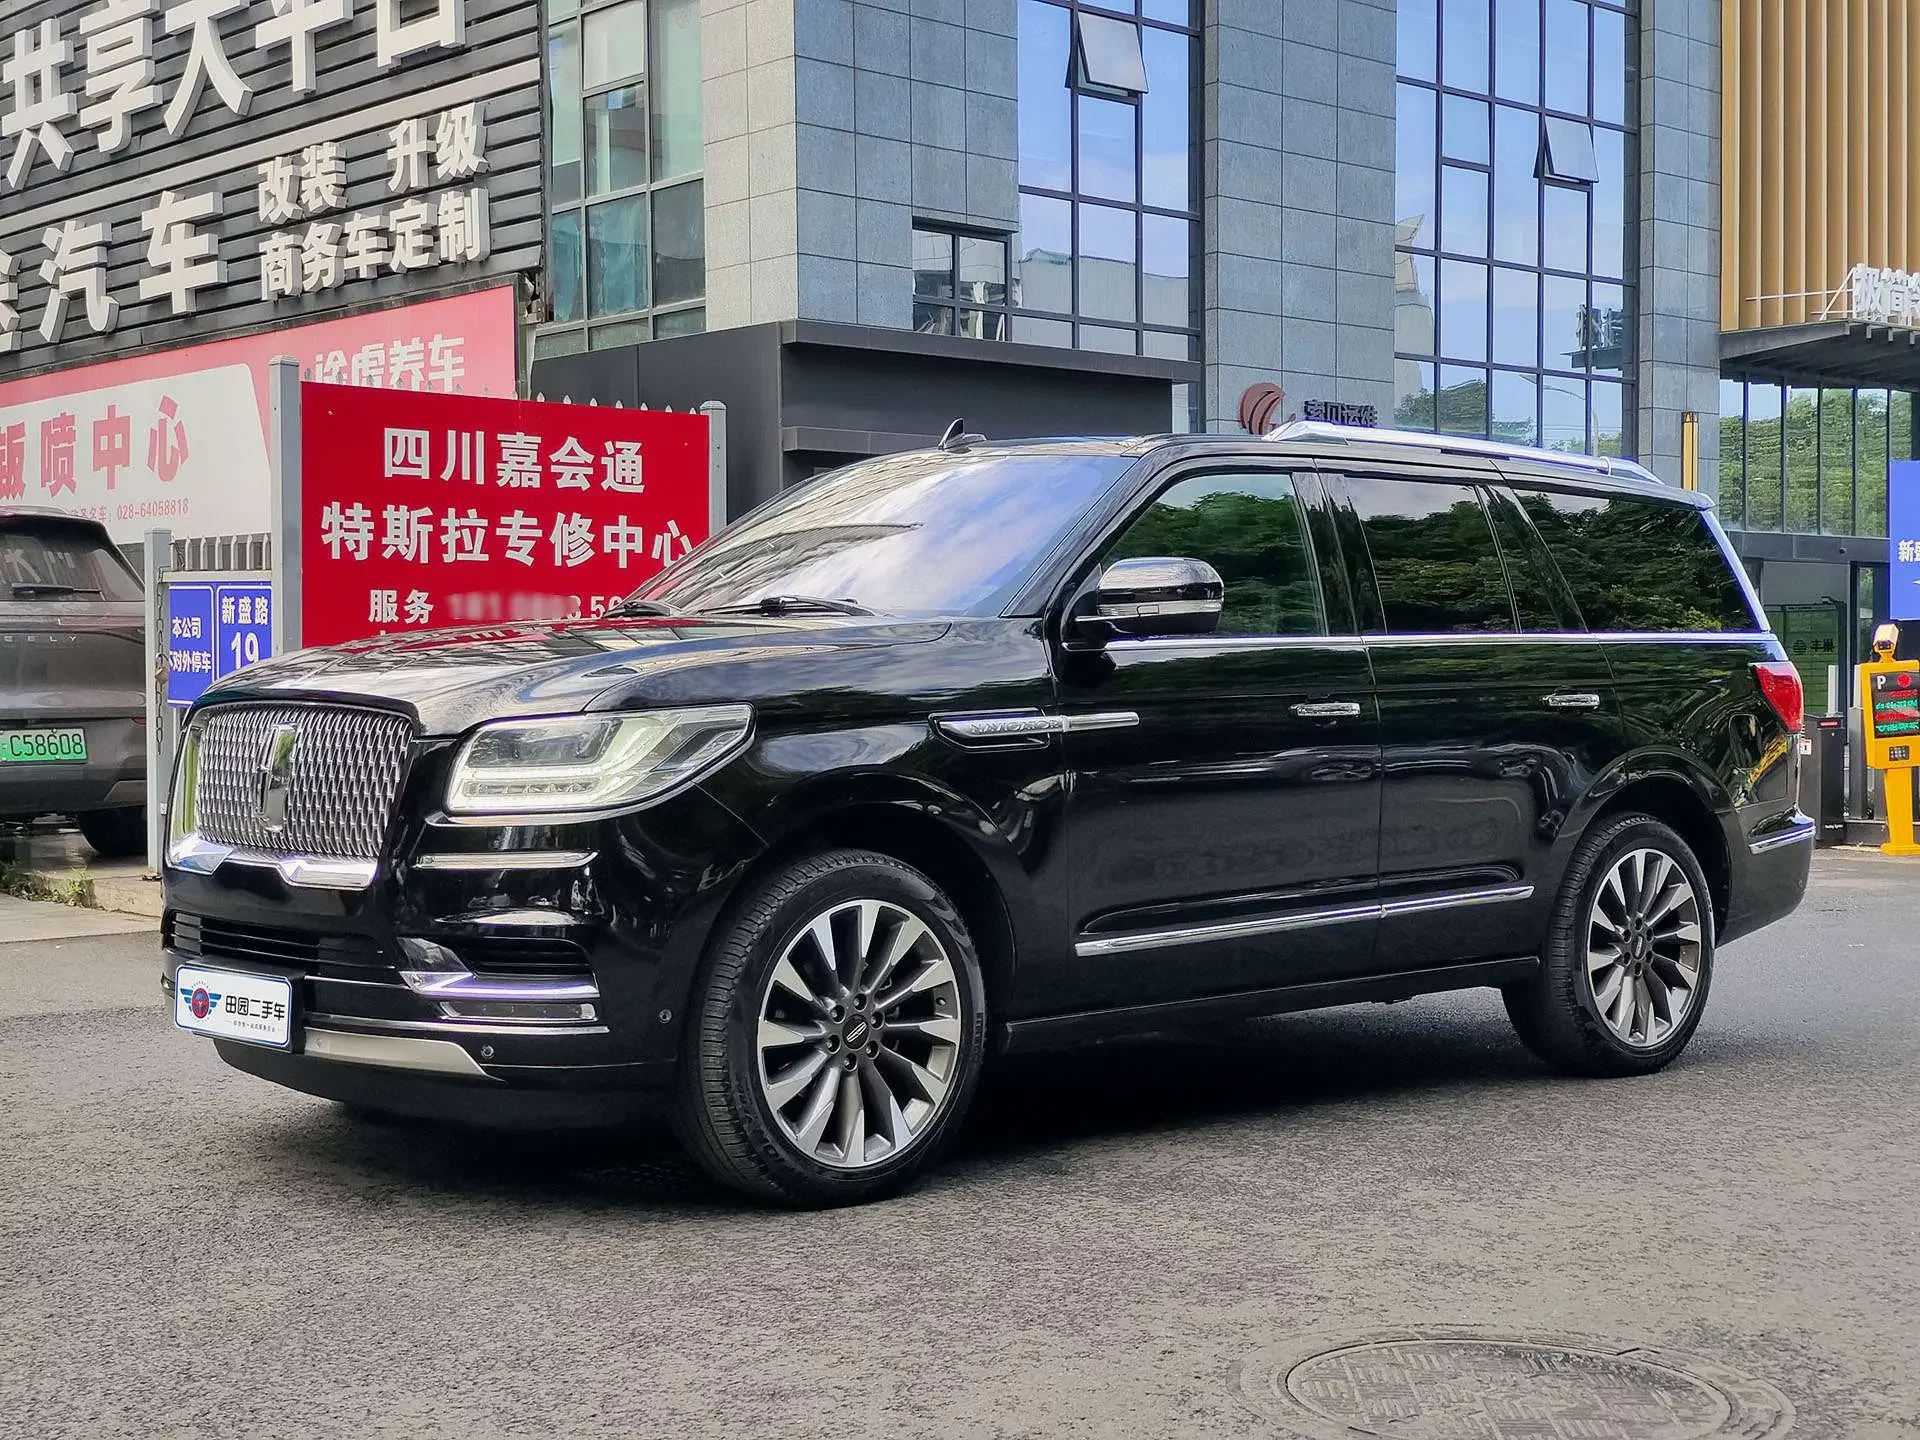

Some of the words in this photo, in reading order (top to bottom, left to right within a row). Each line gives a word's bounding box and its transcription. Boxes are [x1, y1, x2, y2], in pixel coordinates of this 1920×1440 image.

[258, 141, 349, 225] 改装
[387, 101, 489, 194] 升级
[259, 186, 490, 302] 商务车定制
[315, 333, 465, 393] 途虎养车
[384, 427, 646, 494] 四川嘉会通
[320, 501, 694, 569] 特斯拉专修中心
[221, 596, 269, 626] 新盛路
[368, 589, 434, 624] 服务
[171, 616, 202, 639] 本公司
[231, 631, 260, 670] 19
[1876, 675, 1886, 690] P
[10, 734, 83, 756] C58608
[225, 995, 285, 1021] 田园二手车
